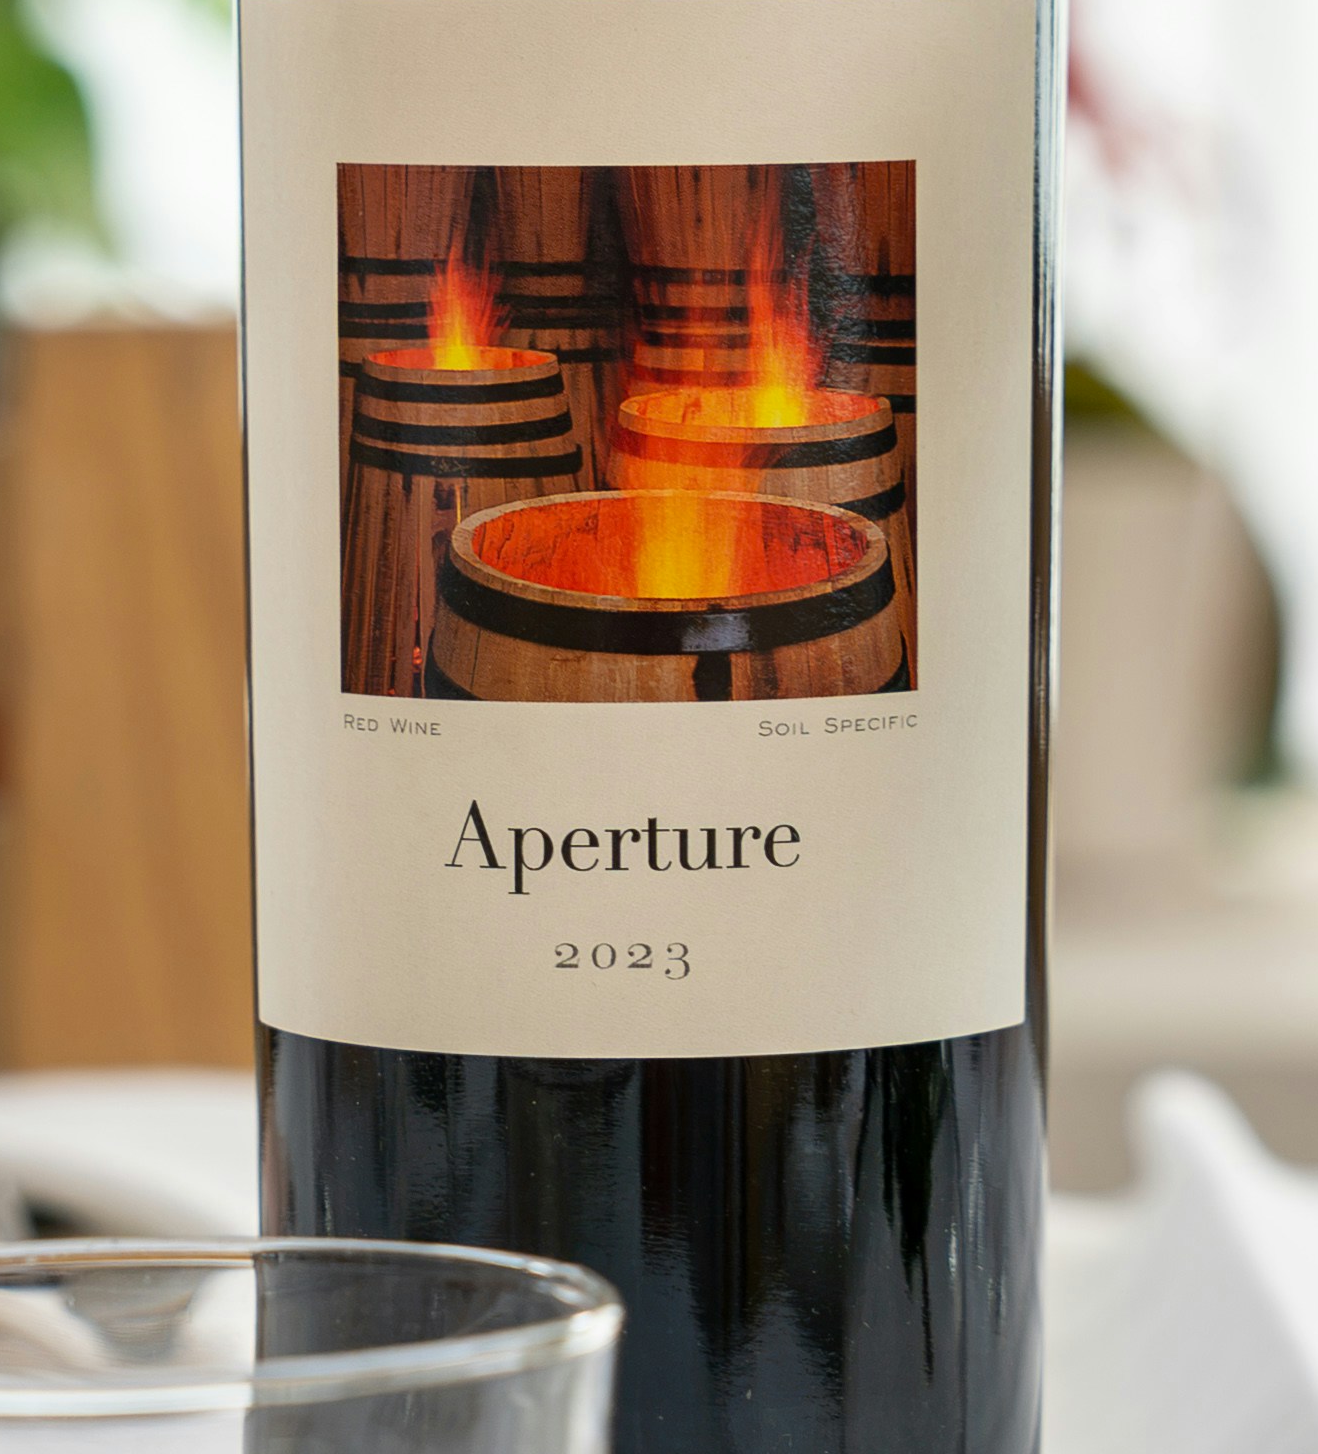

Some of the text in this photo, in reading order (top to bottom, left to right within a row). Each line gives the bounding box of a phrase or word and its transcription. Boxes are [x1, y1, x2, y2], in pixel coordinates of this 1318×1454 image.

[343, 713, 442, 736] RED WINE
[758, 714, 919, 738] SOIL SPECIFIC
[444, 798, 801, 896] Aperture
[554, 942, 691, 981] 2023
